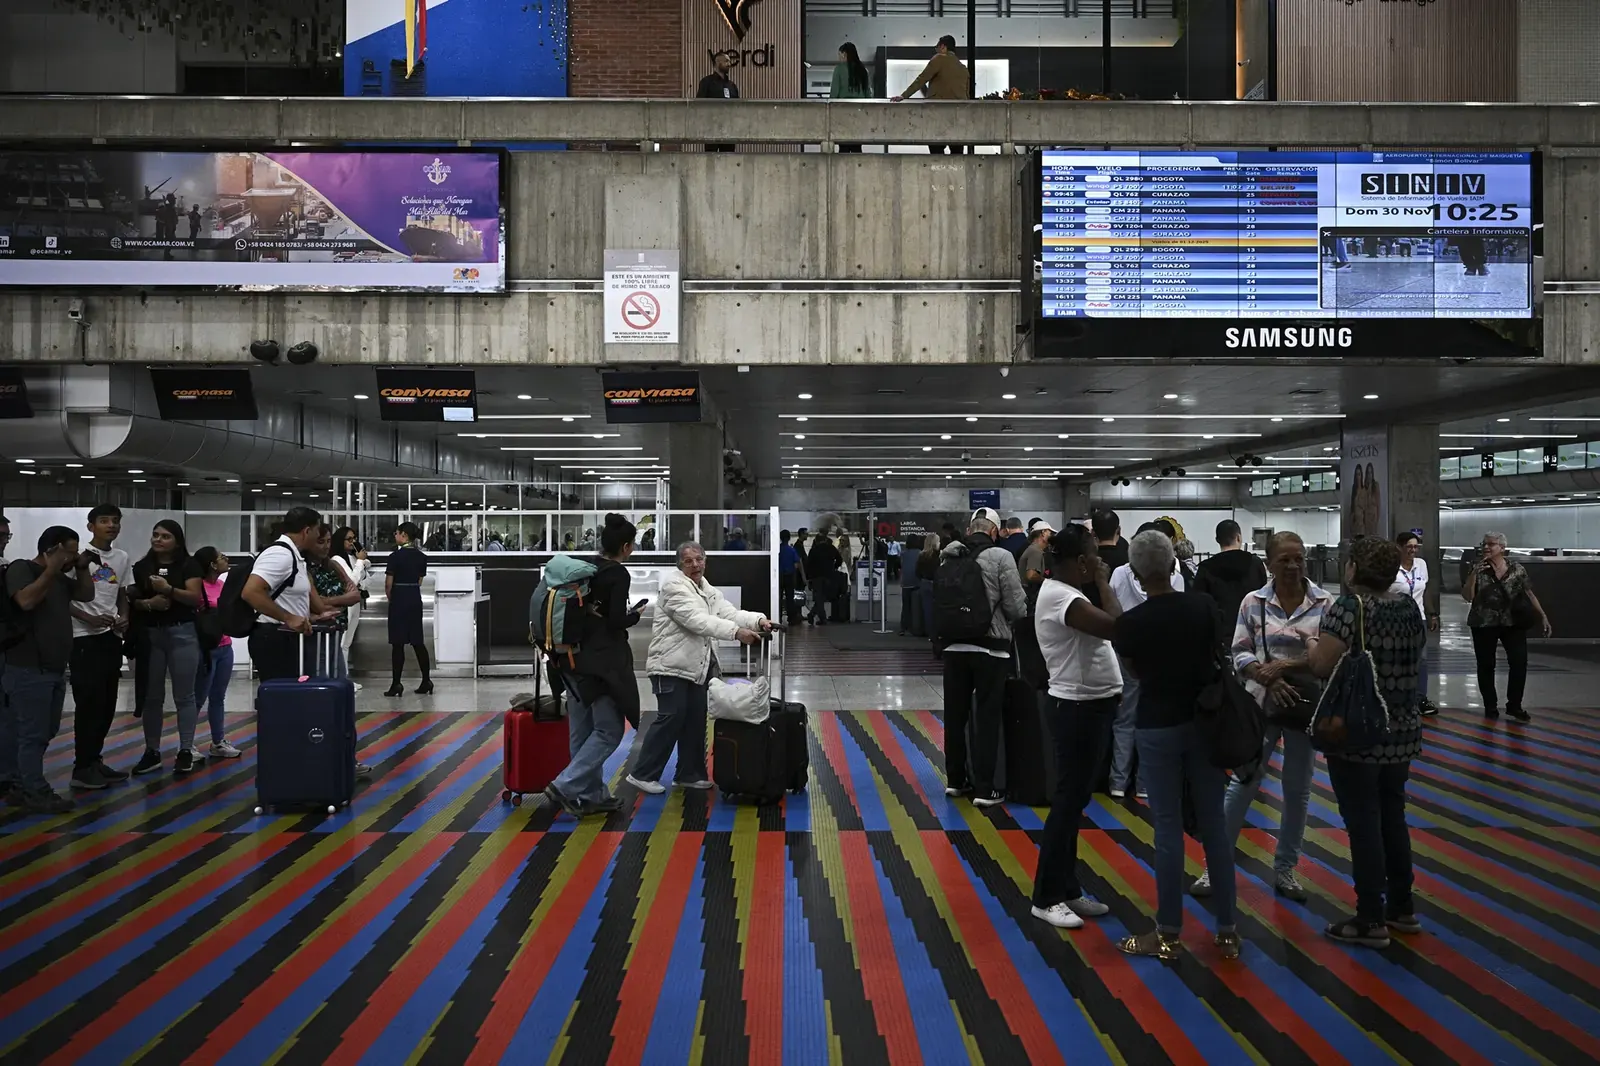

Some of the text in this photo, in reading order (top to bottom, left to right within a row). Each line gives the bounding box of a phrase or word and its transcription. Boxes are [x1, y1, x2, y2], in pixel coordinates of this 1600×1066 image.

[1364, 176, 1482, 193] SINIV
[401, 196, 431, 204] Soluciones
[444, 196, 473, 206] Navegan
[452, 207, 468, 215] Mar
[1428, 204, 1518, 221] 10:25
[1225, 327, 1352, 348] SAMSUNG
[380, 387, 472, 397] conviasa
[604, 388, 696, 398] conviasa
